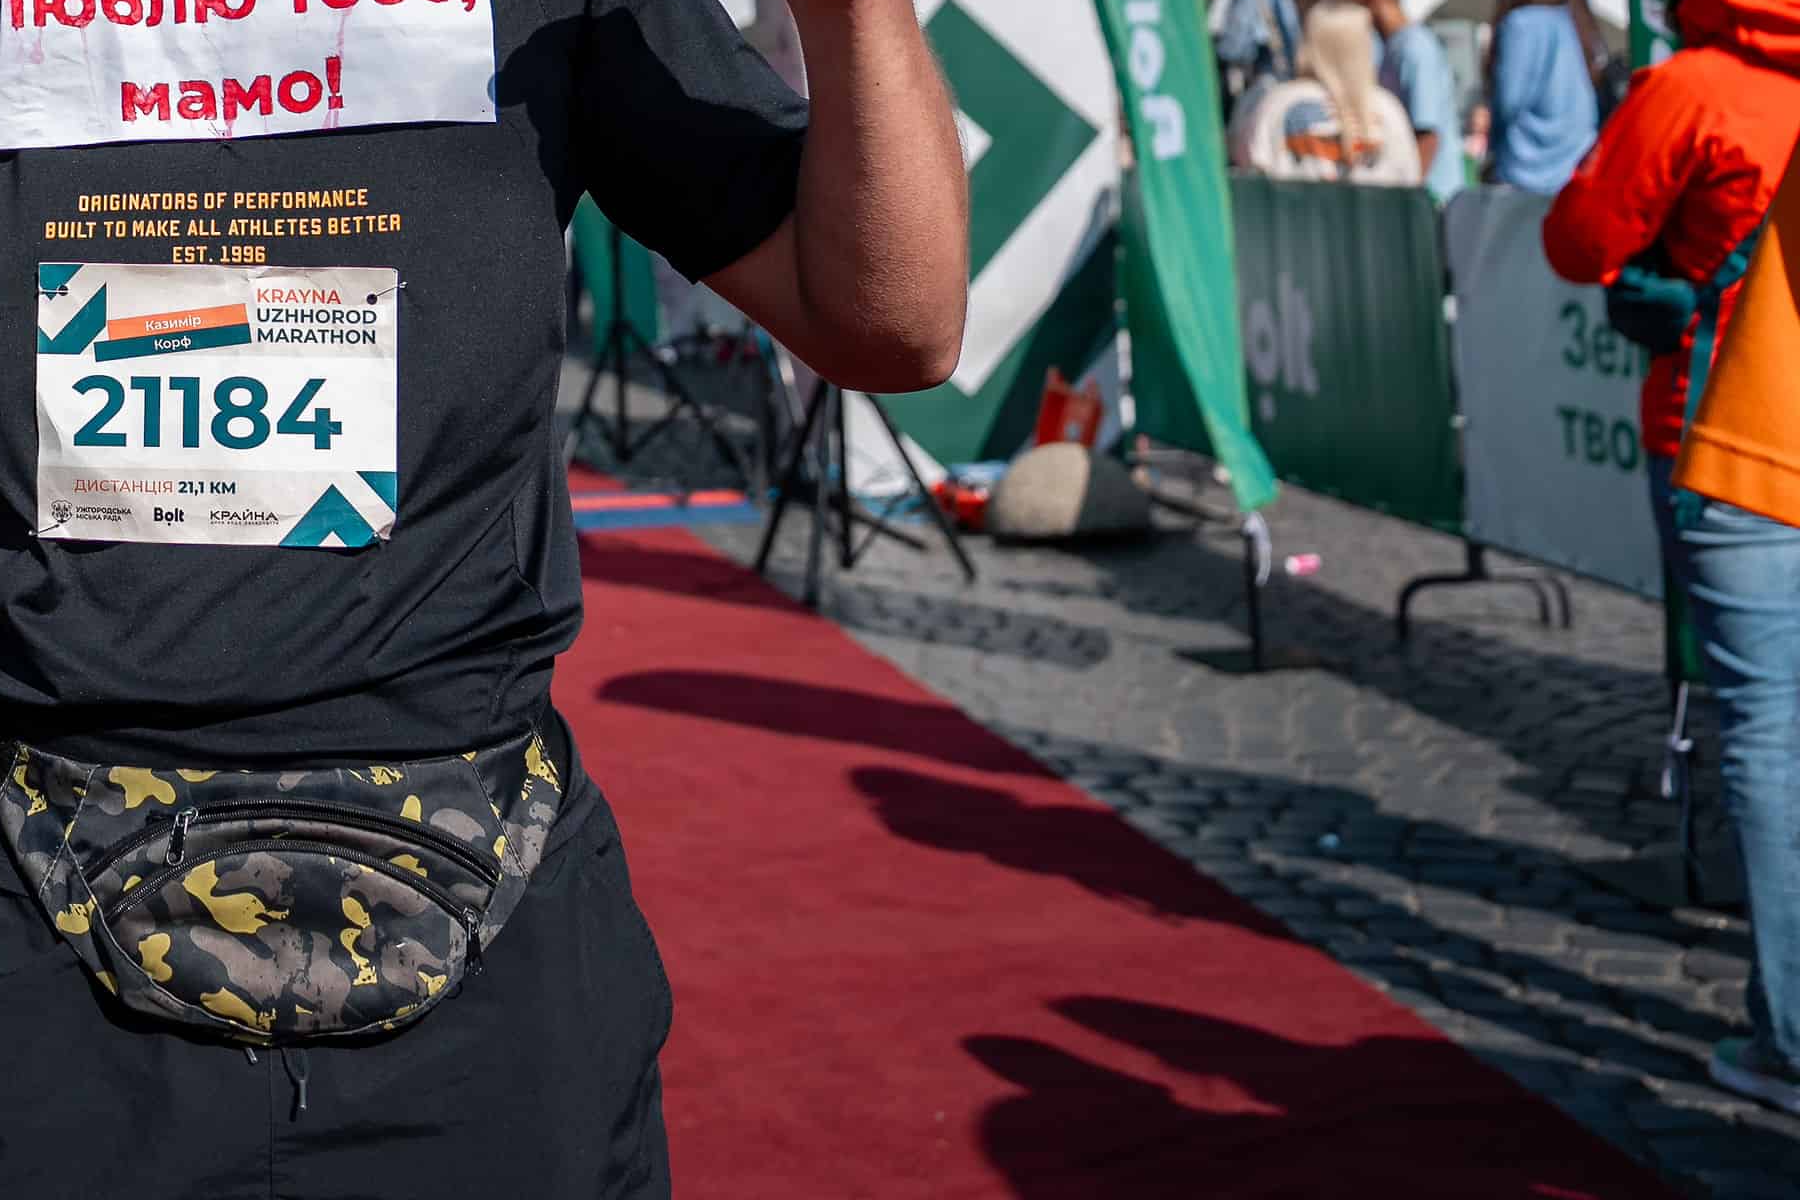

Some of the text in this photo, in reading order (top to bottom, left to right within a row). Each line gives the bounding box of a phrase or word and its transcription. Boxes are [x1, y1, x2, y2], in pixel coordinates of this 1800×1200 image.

[121, 56, 343, 122] мамо!
[78, 188, 369, 213] ORIGINATORS OF PERFORMANCE
[45, 214, 401, 240] BUILT TO MAKE ALL ATHLETES BETTER
[172, 245, 266, 264] EST. 1996
[256, 288, 342, 305] KRAYNA
[145, 314, 202, 332] Казимір
[256, 308, 377, 324] UZHHOROD
[153, 334, 192, 352] Корф
[257, 328, 377, 345] MARATHON
[71, 373, 343, 450] 21184
[73, 478, 236, 497] ДИСТАНЦІЯ 21,1 КМ
[75, 505, 132, 515] УЖГОРОДСЬКА
[153, 507, 185, 526] Bolt
[210, 508, 279, 521] КРАЙНА
